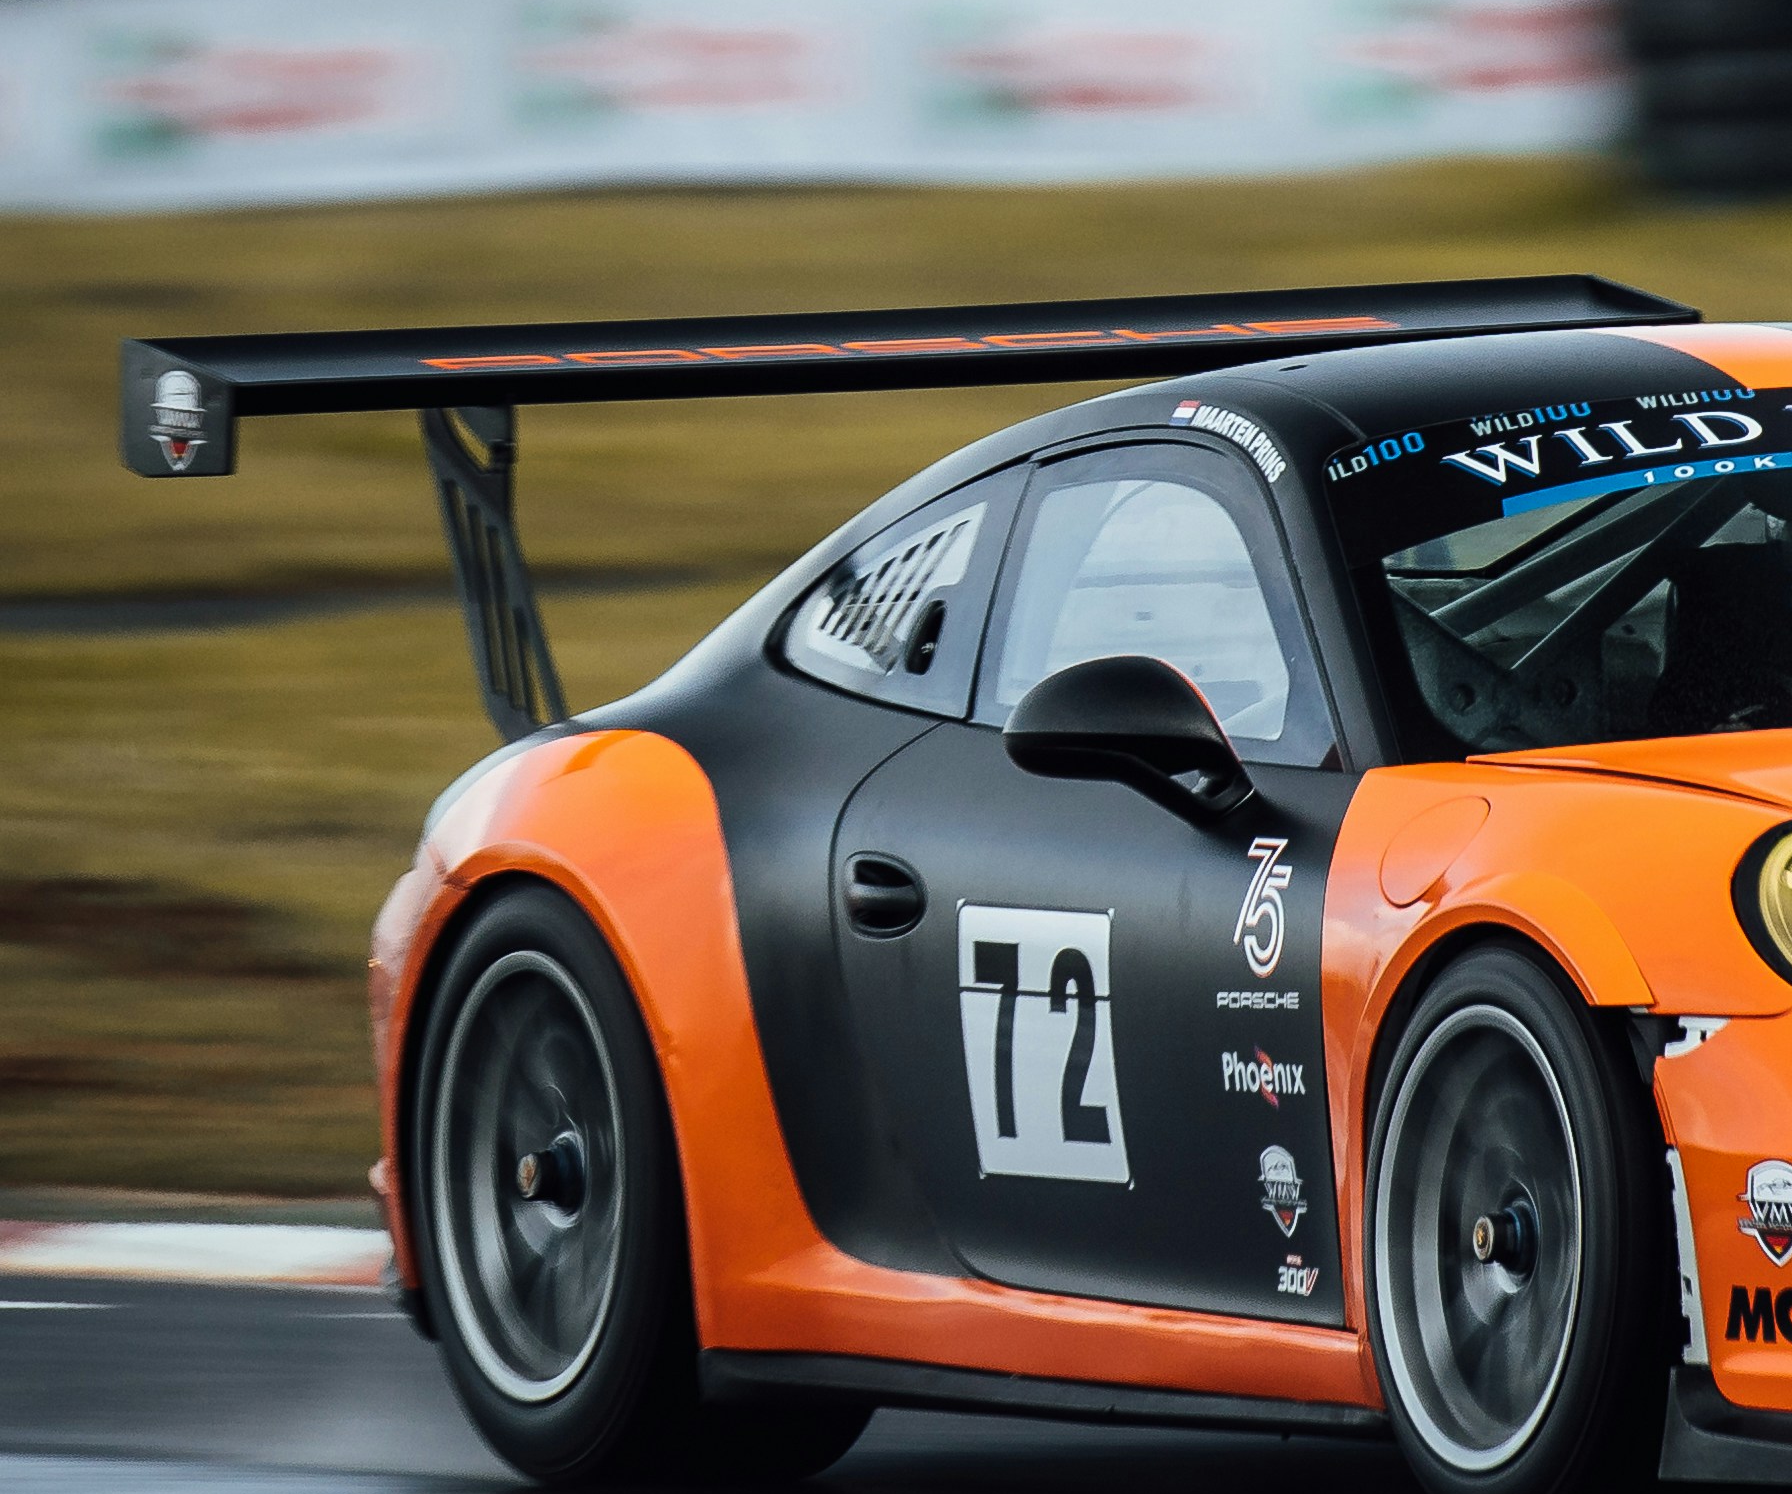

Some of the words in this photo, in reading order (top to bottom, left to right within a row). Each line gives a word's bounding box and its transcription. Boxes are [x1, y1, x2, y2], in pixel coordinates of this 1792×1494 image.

[1189, 404, 1260, 448] MAARTEN
[1250, 432, 1287, 483] PRINS
[1439, 411, 1764, 486] WILD
[1216, 991, 1300, 1010] PORSCHE
[973, 940, 1112, 1145] 72
[1221, 1051, 1306, 1095] Phoenix
[1277, 1265, 1320, 1297] 300V
